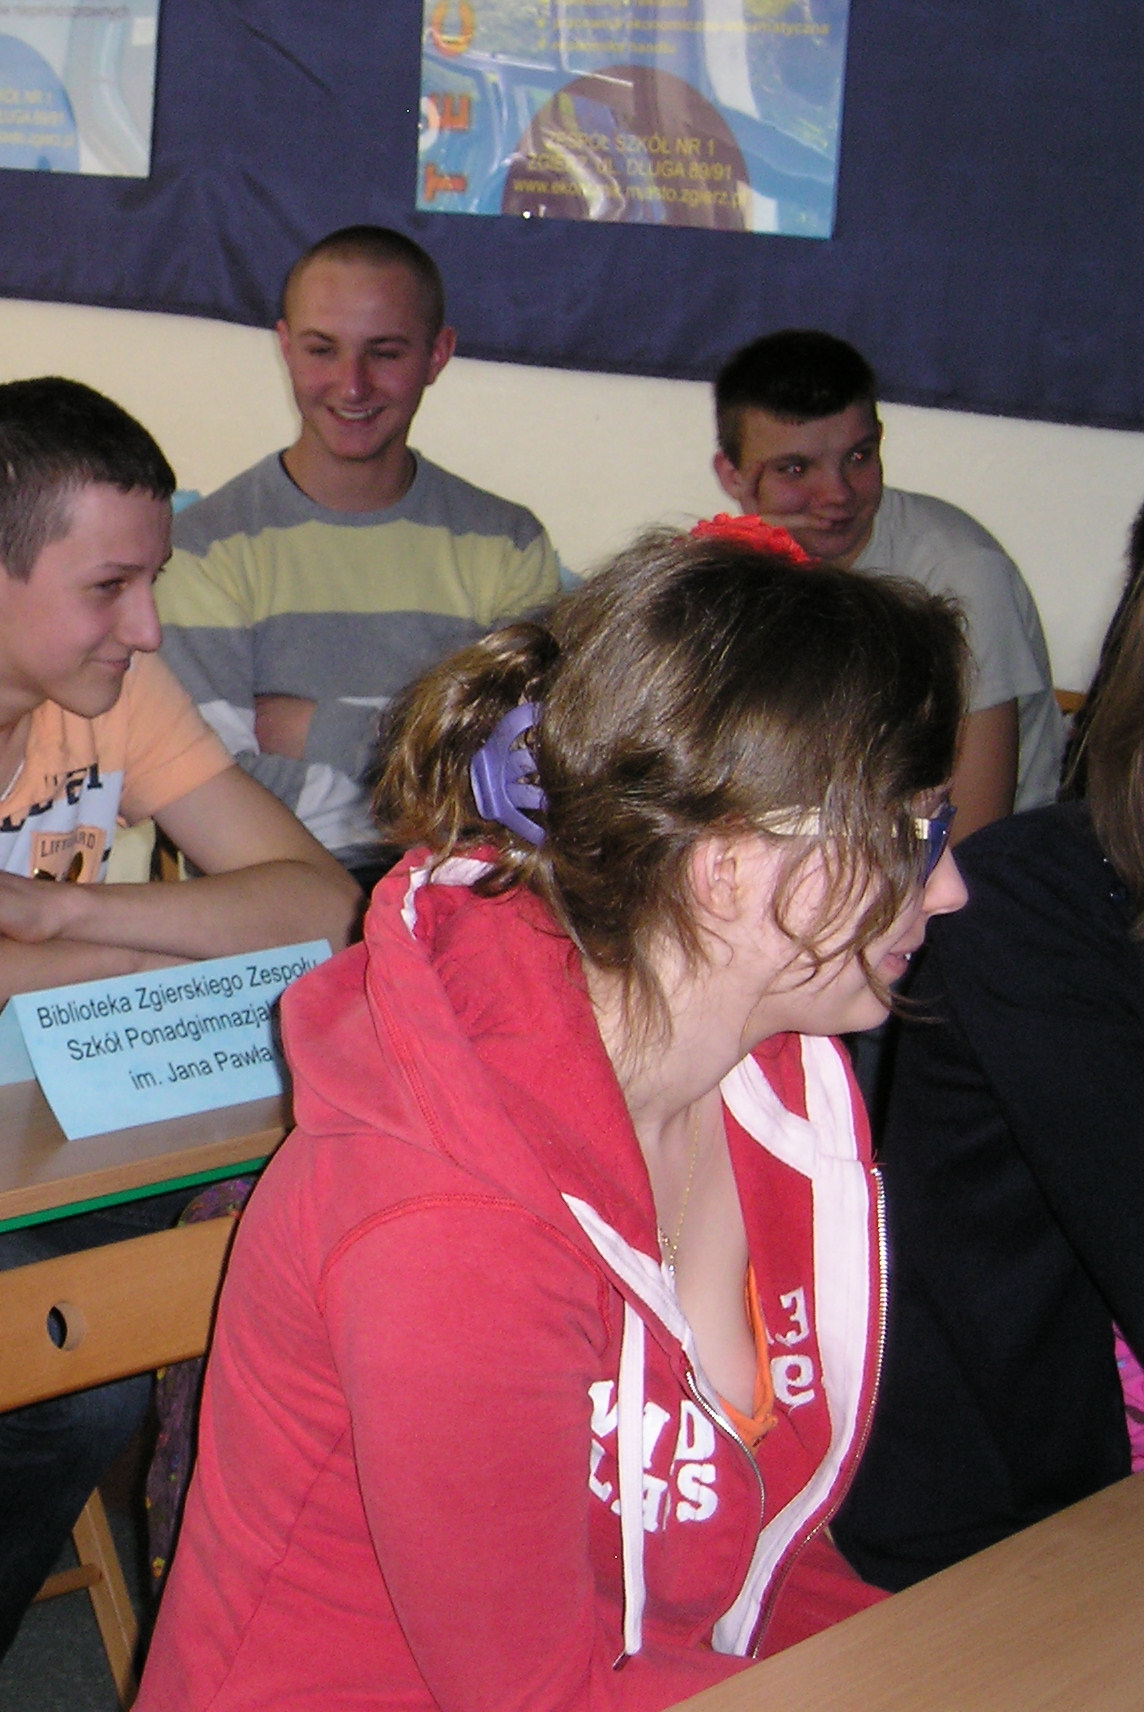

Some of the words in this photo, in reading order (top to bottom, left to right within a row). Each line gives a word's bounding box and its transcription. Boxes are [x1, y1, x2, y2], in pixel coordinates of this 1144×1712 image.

[676, 137, 702, 156] NR
[708, 139, 716, 157] 1
[37, 994, 132, 1029] Biblioteka
[136, 975, 243, 1012] Zgierskiego
[67, 1031, 123, 1061] Szkół
[129, 1070, 162, 1091] im.
[168, 1060, 213, 1083] Jana
[214, 1045, 274, 1071] Pawła
